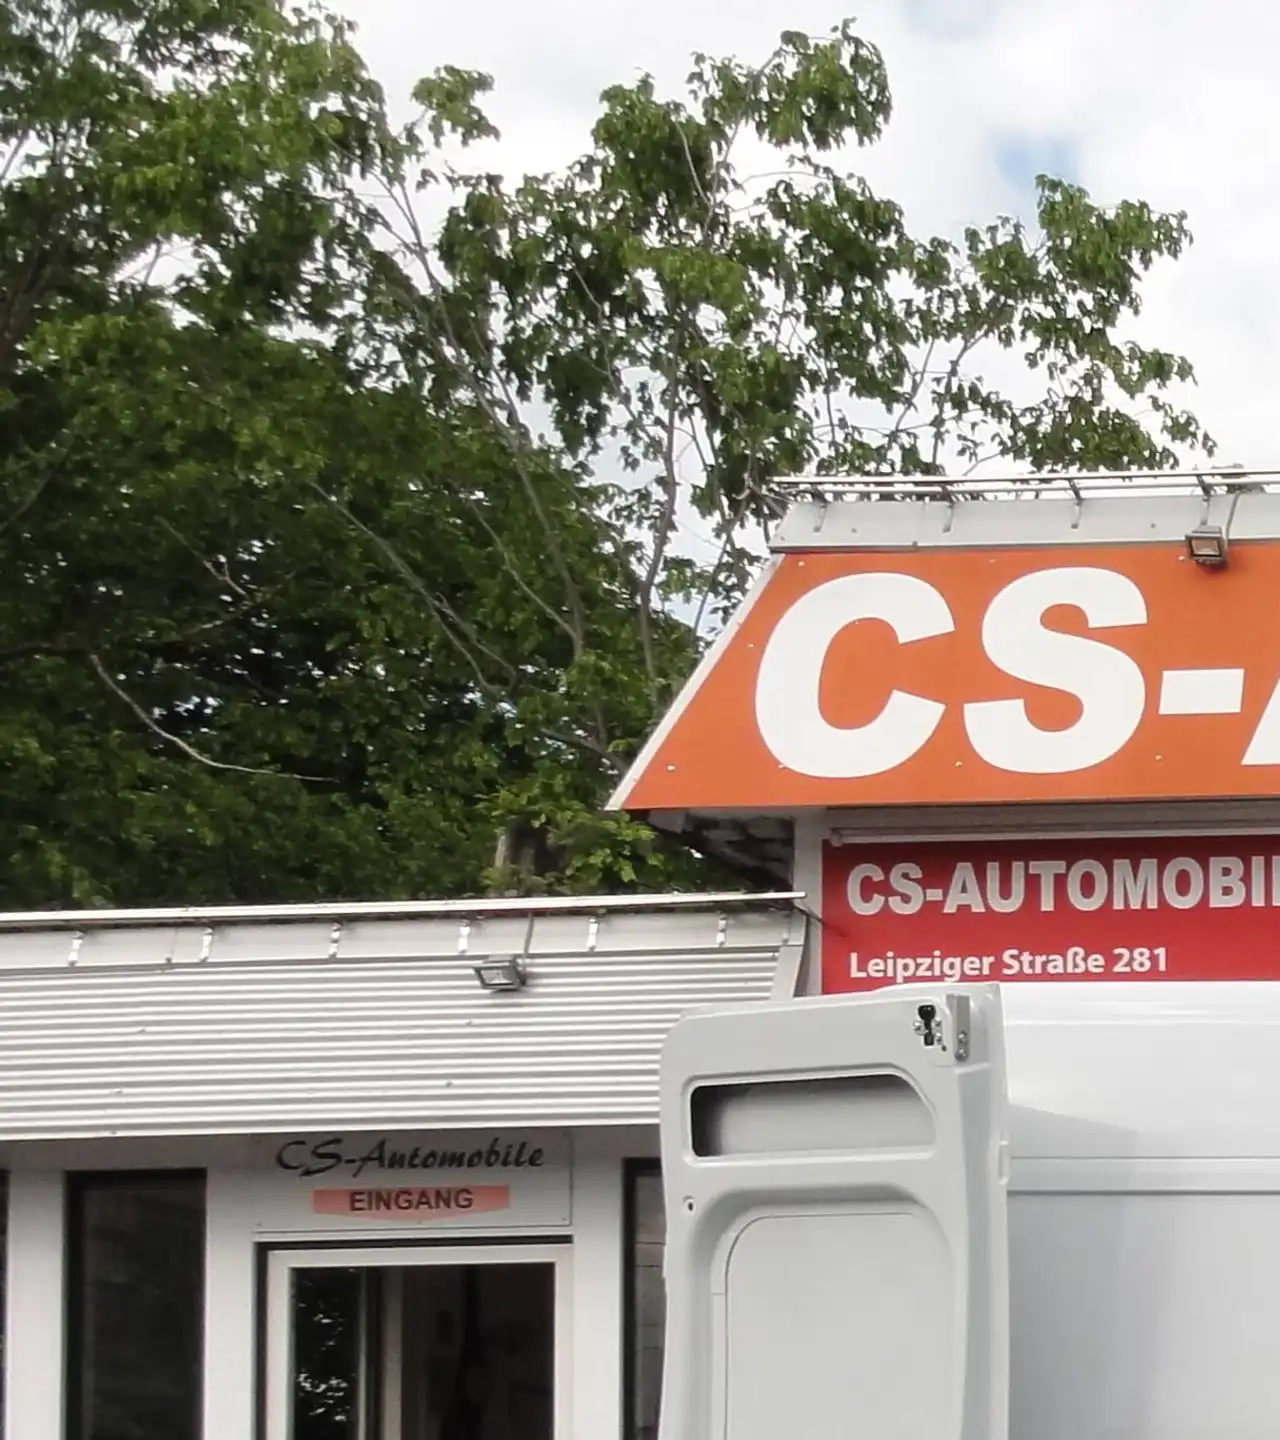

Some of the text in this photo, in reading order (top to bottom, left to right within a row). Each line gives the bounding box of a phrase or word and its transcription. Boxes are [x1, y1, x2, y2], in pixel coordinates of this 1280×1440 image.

[849, 946, 1168, 983] Leipziger Straße 281
[275, 1136, 545, 1179] CS-Automobile
[349, 1188, 474, 1212] EINGANG
